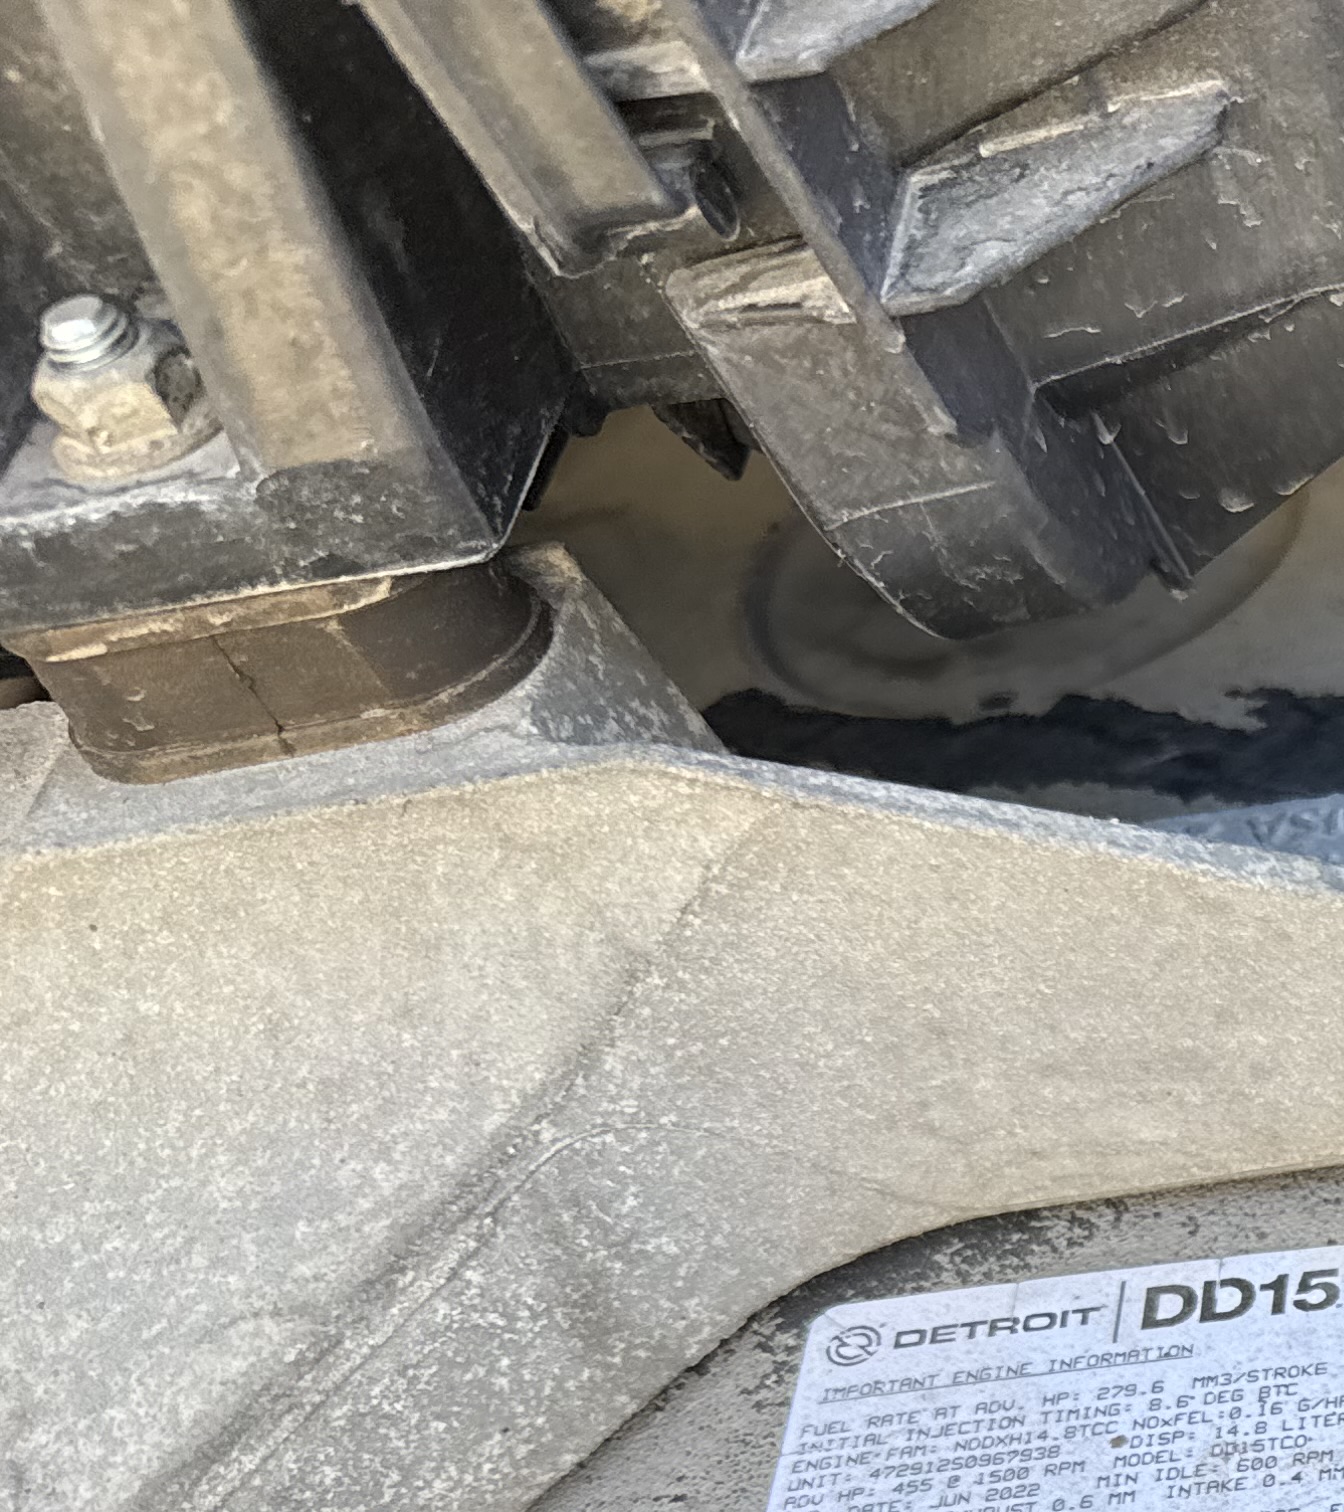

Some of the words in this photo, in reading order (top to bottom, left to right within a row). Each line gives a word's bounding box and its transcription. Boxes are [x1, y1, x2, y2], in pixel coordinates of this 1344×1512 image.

[892, 1306, 1110, 1350] DETROIT
[1141, 1268, 1341, 1331] DD15
[819, 1373, 939, 1401] IMPORTANT
[952, 1361, 1033, 1385] ENGINE
[1046, 1341, 1193, 1373] INFORMATION
[799, 1417, 853, 1437] FUEL
[865, 1409, 920, 1429] RATE
[933, 1405, 961, 1421] AT
[1042, 1390, 1080, 1408] HP:
[1096, 1380, 1164, 1402] 279.6
[902, 1414, 1026, 1442] INJECTION
[1039, 1401, 1132, 1425] TIMING:
[1148, 1394, 1189, 1412] 8.6
[1203, 1387, 1243, 1405] DEG
[782, 1490, 823, 1509] ADV
[836, 1484, 875, 1502] HP:
[891, 1477, 933, 1496] 455
[974, 1466, 1030, 1486] 1500
[1043, 1459, 1085, 1478] RPM
[786, 1470, 852, 1491] UNIT:
[1129, 1428, 1195, 1450] DISP:
[1212, 1420, 1267, 1440] 14.8
[790, 1450, 872, 1473] ENGINE
[929, 1491, 971, 1510] JUN
[984, 1482, 1041, 1503] 2022
[1096, 1471, 1138, 1490] MIN
[1236, 1454, 1277, 1473] 600
[1292, 1447, 1333, 1466] RPM
[1051, 1494, 1094, 1512] 0.6
[1107, 1489, 1135, 1506] MM
[1163, 1475, 1247, 1500] INTAKE
[1262, 1469, 1303, 1488] 0.4
[1318, 1464, 1344, 1481] MM
